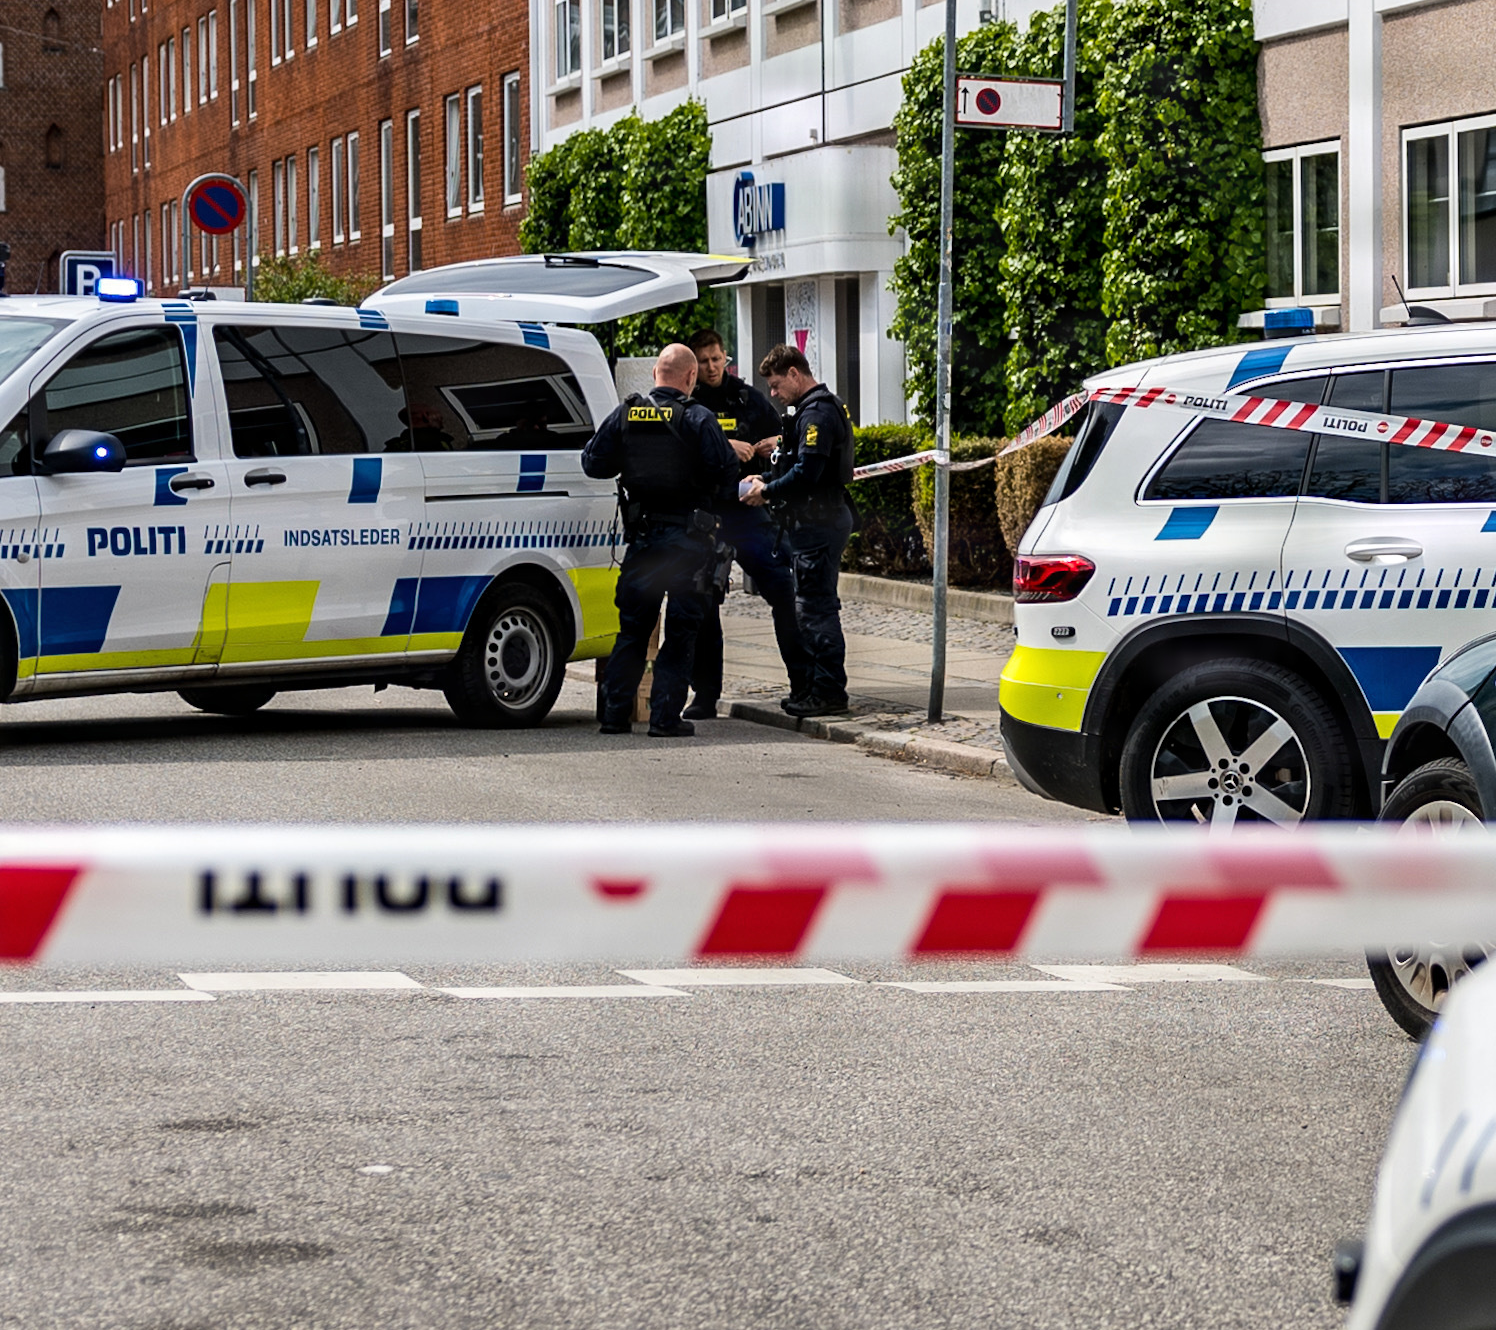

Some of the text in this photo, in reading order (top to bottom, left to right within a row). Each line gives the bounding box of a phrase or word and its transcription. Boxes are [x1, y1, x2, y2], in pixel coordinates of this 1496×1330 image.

[733, 170, 778, 248] CABINN
[76, 263, 102, 296] P
[1183, 395, 1228, 411] POLITI
[630, 409, 672, 419] POLII
[1322, 416, 1368, 433] POLITI
[86, 525, 186, 557] POLITI
[284, 528, 400, 547] INDSATSLEDER
